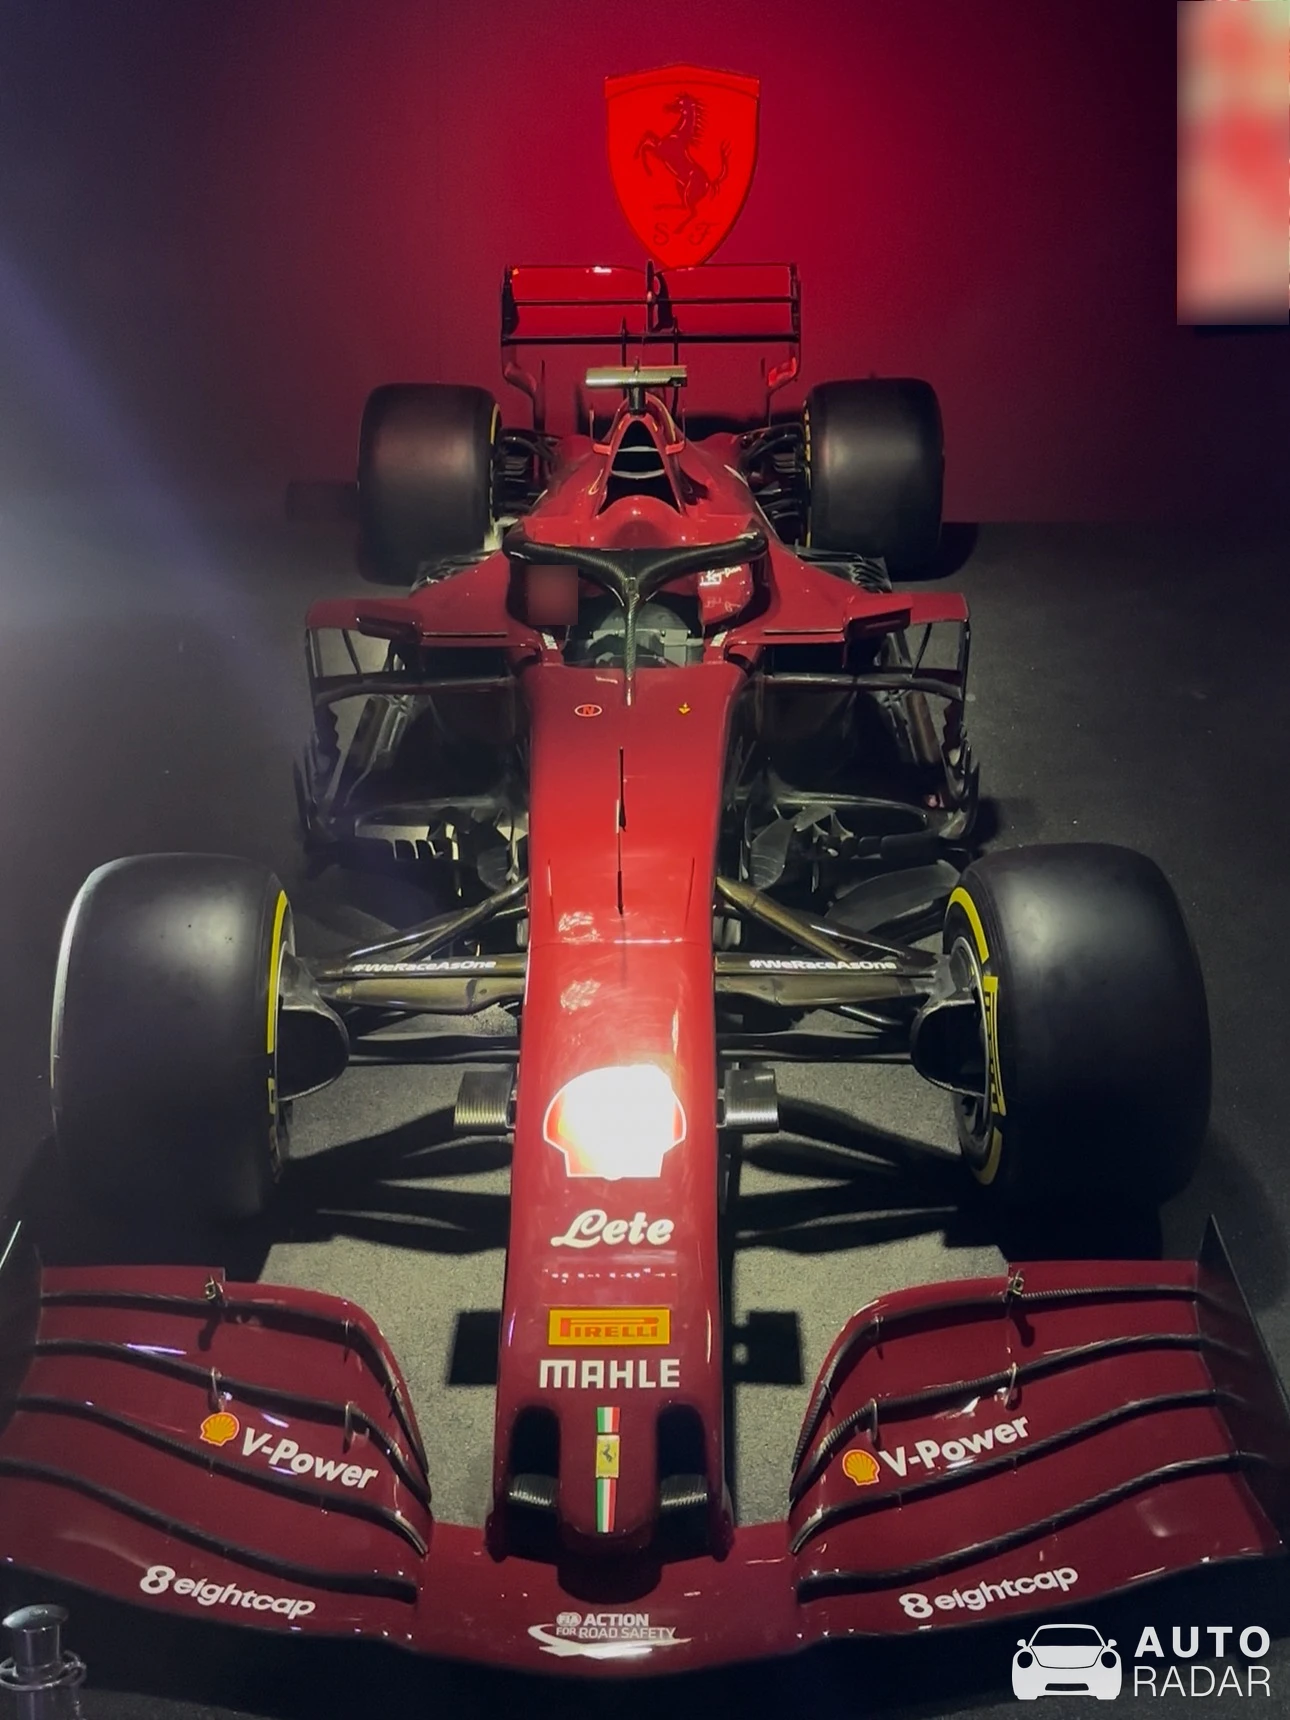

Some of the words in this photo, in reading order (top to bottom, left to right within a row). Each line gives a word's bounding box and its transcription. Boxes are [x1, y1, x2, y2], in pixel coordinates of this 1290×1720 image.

[352, 961, 497, 972] #WeRaceAsOne
[750, 960, 897, 970] #WeRaceAsOne
[551, 1209, 675, 1248] Lete
[560, 1317, 660, 1337] PIRELLI
[539, 1359, 680, 1389] MAHLE
[242, 1427, 379, 1489] V-Power
[879, 1416, 1029, 1477] V-Power
[173, 1578, 316, 1620] eightcap
[934, 1567, 1078, 1611] eightcap
[556, 1628, 577, 1636] FOR
[578, 1628, 618, 1639] ROAD
[620, 1627, 676, 1639] SAFETY
[557, 1613, 581, 1626] FIA
[583, 1613, 649, 1626] ACTION
